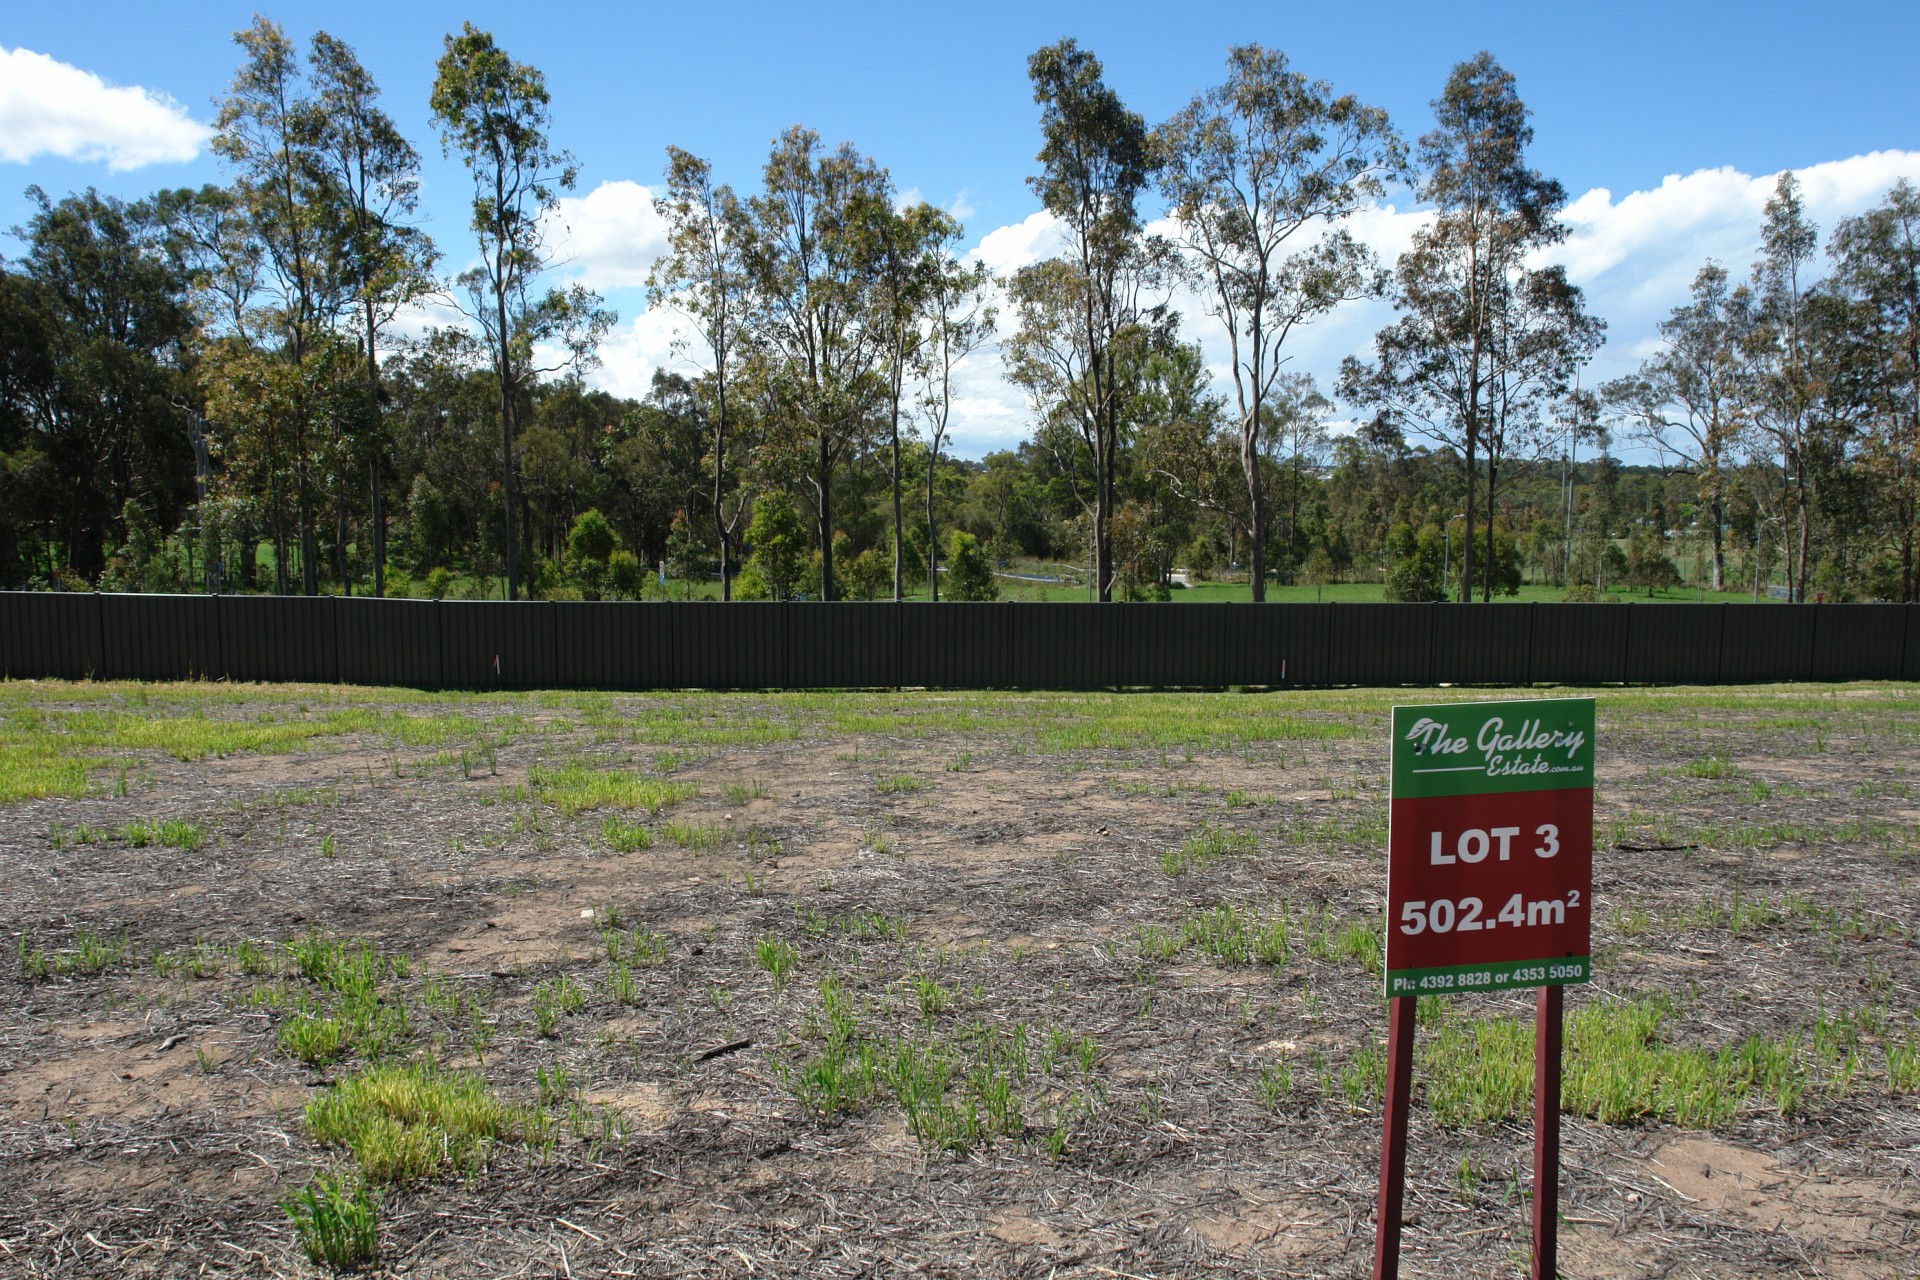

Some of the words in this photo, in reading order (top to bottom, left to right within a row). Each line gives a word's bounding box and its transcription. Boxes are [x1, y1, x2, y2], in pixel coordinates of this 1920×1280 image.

[1405, 717, 1468, 756] The
[1477, 716, 1585, 759] Gallery
[1430, 827, 1520, 865] LOT
[1535, 824, 1560, 859] 3
[1420, 974, 1454, 989] 4392
[1458, 972, 1491, 986] 8828
[1495, 973, 1510, 984] or
[1513, 967, 1546, 983] 4353
[1549, 965, 1583, 979] 5050
